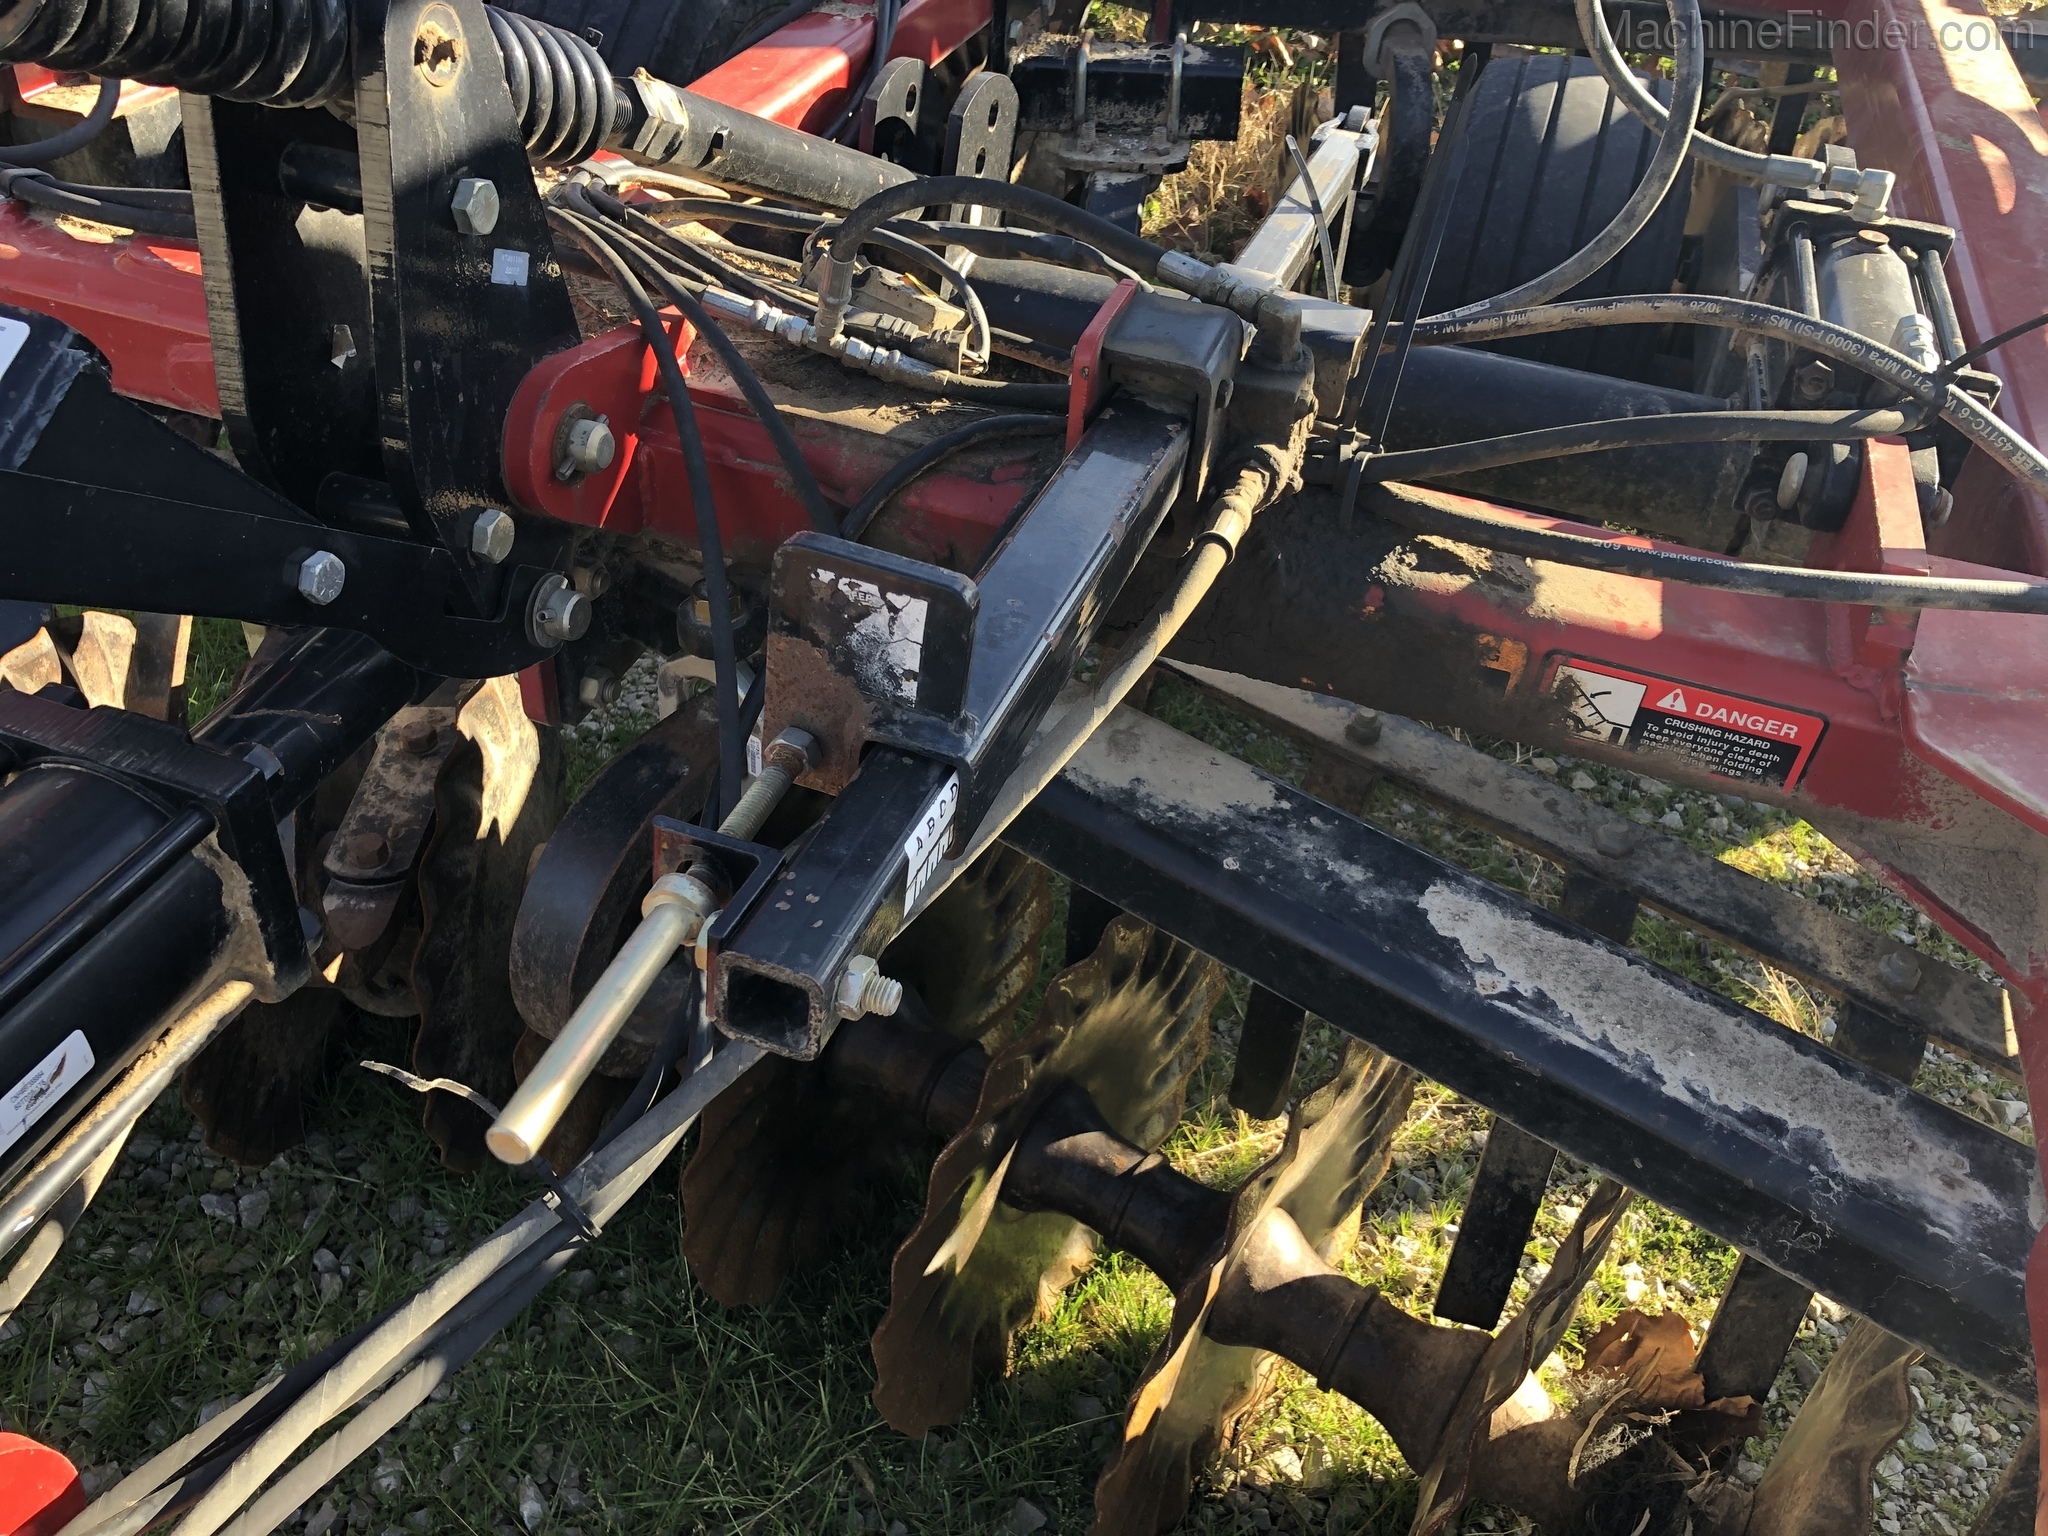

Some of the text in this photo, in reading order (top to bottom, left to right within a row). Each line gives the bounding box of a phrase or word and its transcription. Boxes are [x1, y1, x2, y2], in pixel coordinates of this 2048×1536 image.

[1794, 321, 1824, 341] PSI)
[1825, 333, 1866, 358] (3000
[1870, 352, 1901, 376] MPa
[1958, 407, 2014, 452] 451TC-6
[1627, 545, 1734, 568] www.parker.com
[1664, 717, 1770, 750] CRUSHING HAZARD
[1695, 703, 1799, 739] DANGER
[1642, 731, 1772, 768] keep everyone clear of
[1646, 722, 1781, 763] To avoid injury or death
[1690, 751, 1720, 763] when
[1723, 757, 1763, 775] folding
[927, 816, 935, 838] B
[940, 799, 946, 819] C
[950, 782, 959, 802] D
